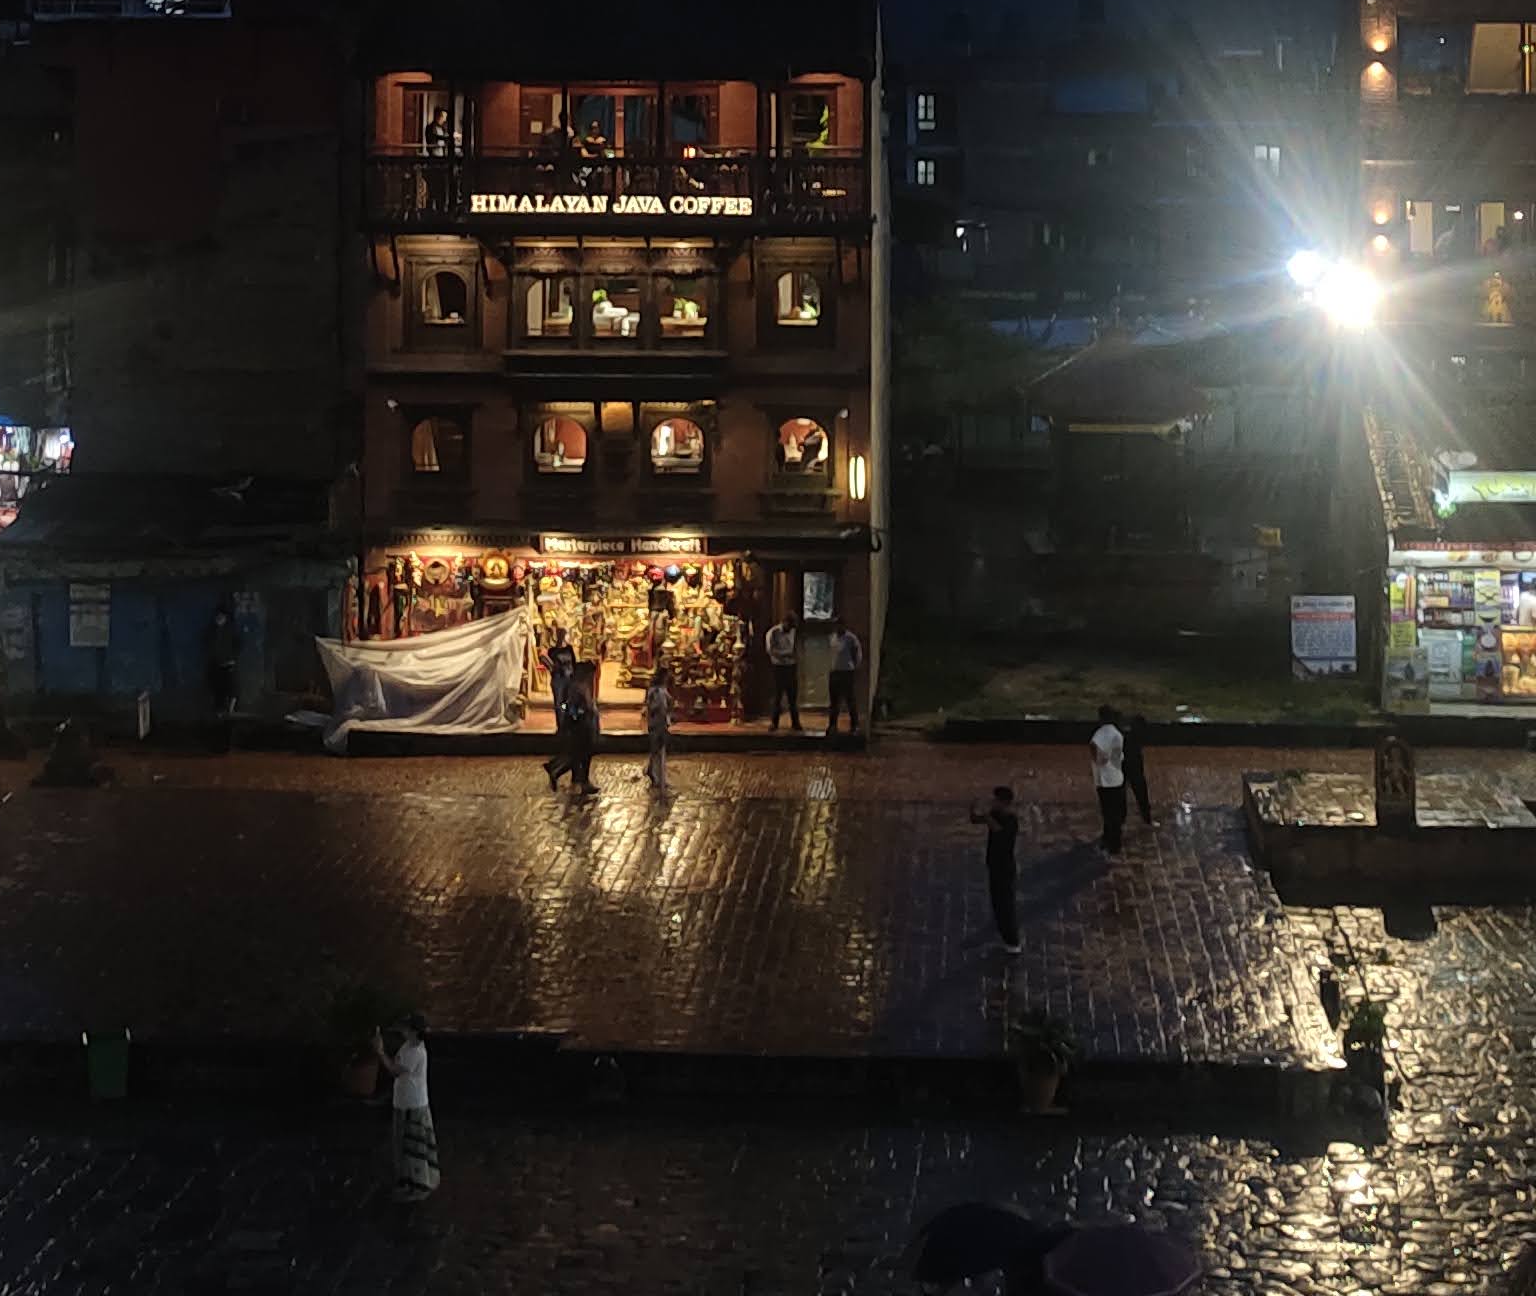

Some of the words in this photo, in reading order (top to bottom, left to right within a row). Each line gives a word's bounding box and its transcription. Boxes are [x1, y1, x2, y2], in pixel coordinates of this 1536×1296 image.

[470, 195, 608, 214] HIMALAYAN
[613, 196, 666, 214] JAVA
[669, 196, 753, 215] COFFEE
[544, 537, 624, 554] Masterpiece
[631, 537, 701, 553] Handicraft
